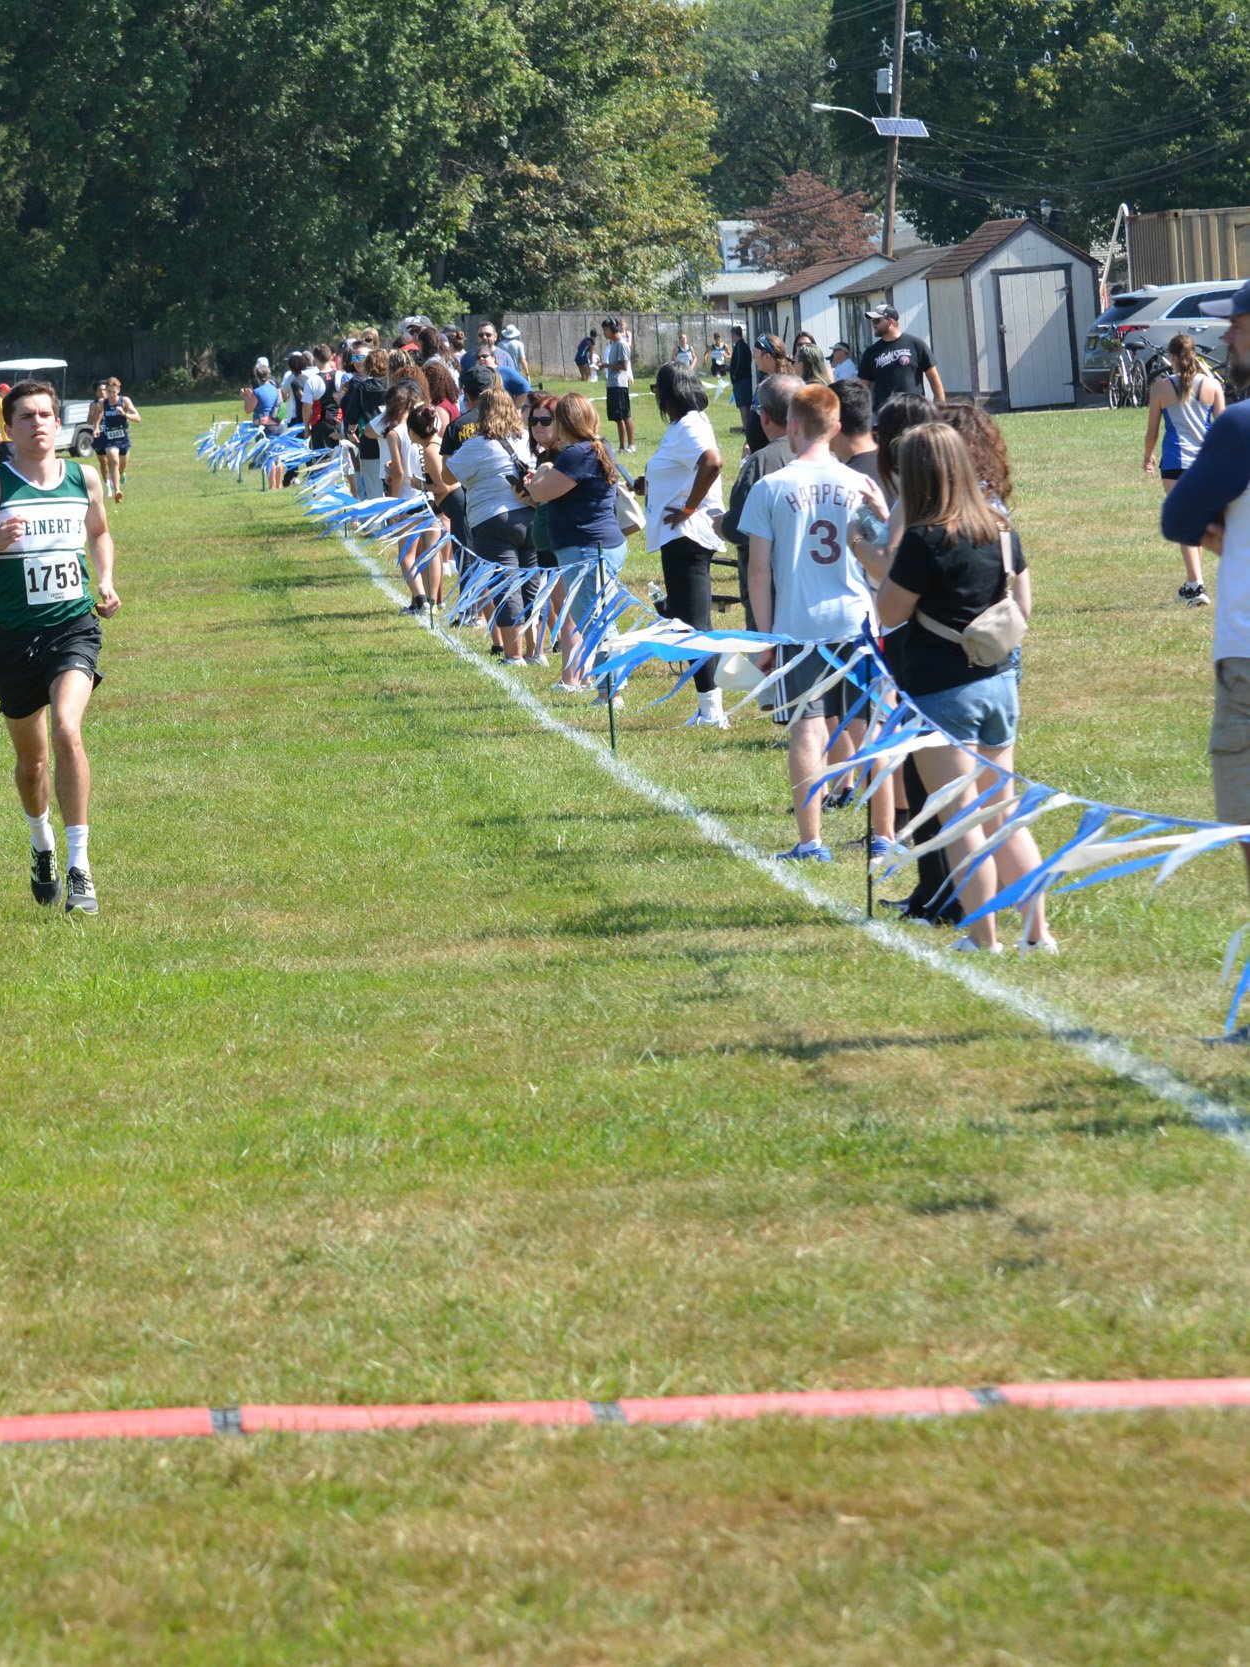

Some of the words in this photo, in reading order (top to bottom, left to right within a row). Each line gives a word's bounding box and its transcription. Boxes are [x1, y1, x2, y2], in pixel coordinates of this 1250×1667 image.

[784, 483, 857, 513] HARPER
[24, 518, 72, 536] EINERT
[809, 519, 841, 565] 3
[27, 561, 80, 593] 1753
